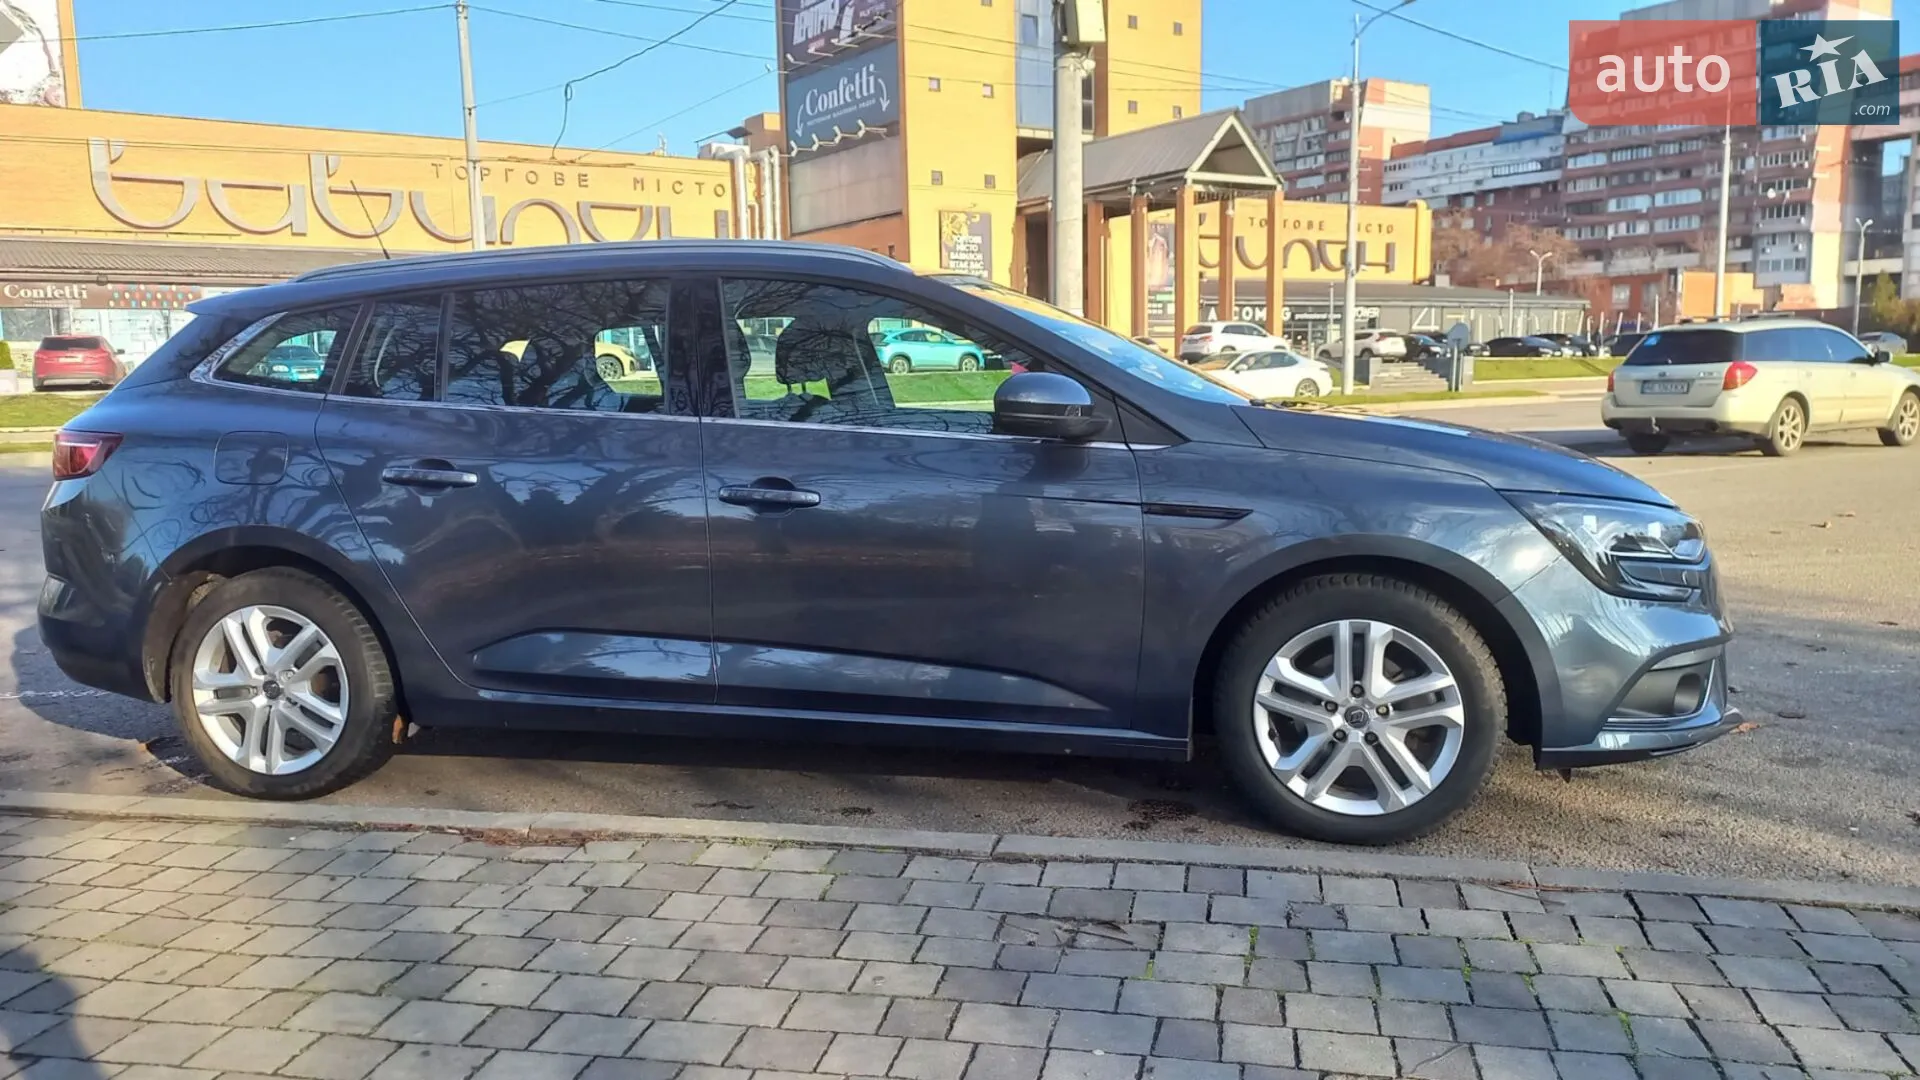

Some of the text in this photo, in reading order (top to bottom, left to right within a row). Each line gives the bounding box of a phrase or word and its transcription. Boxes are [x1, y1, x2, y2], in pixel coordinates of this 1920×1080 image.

[805, 63, 875, 116] Confetti
[431, 162, 726, 198] ТОРГОВЕ МІСТО
[1249, 216, 1325, 231] ТОГОВЕ
[4, 284, 88, 300] Confetti
